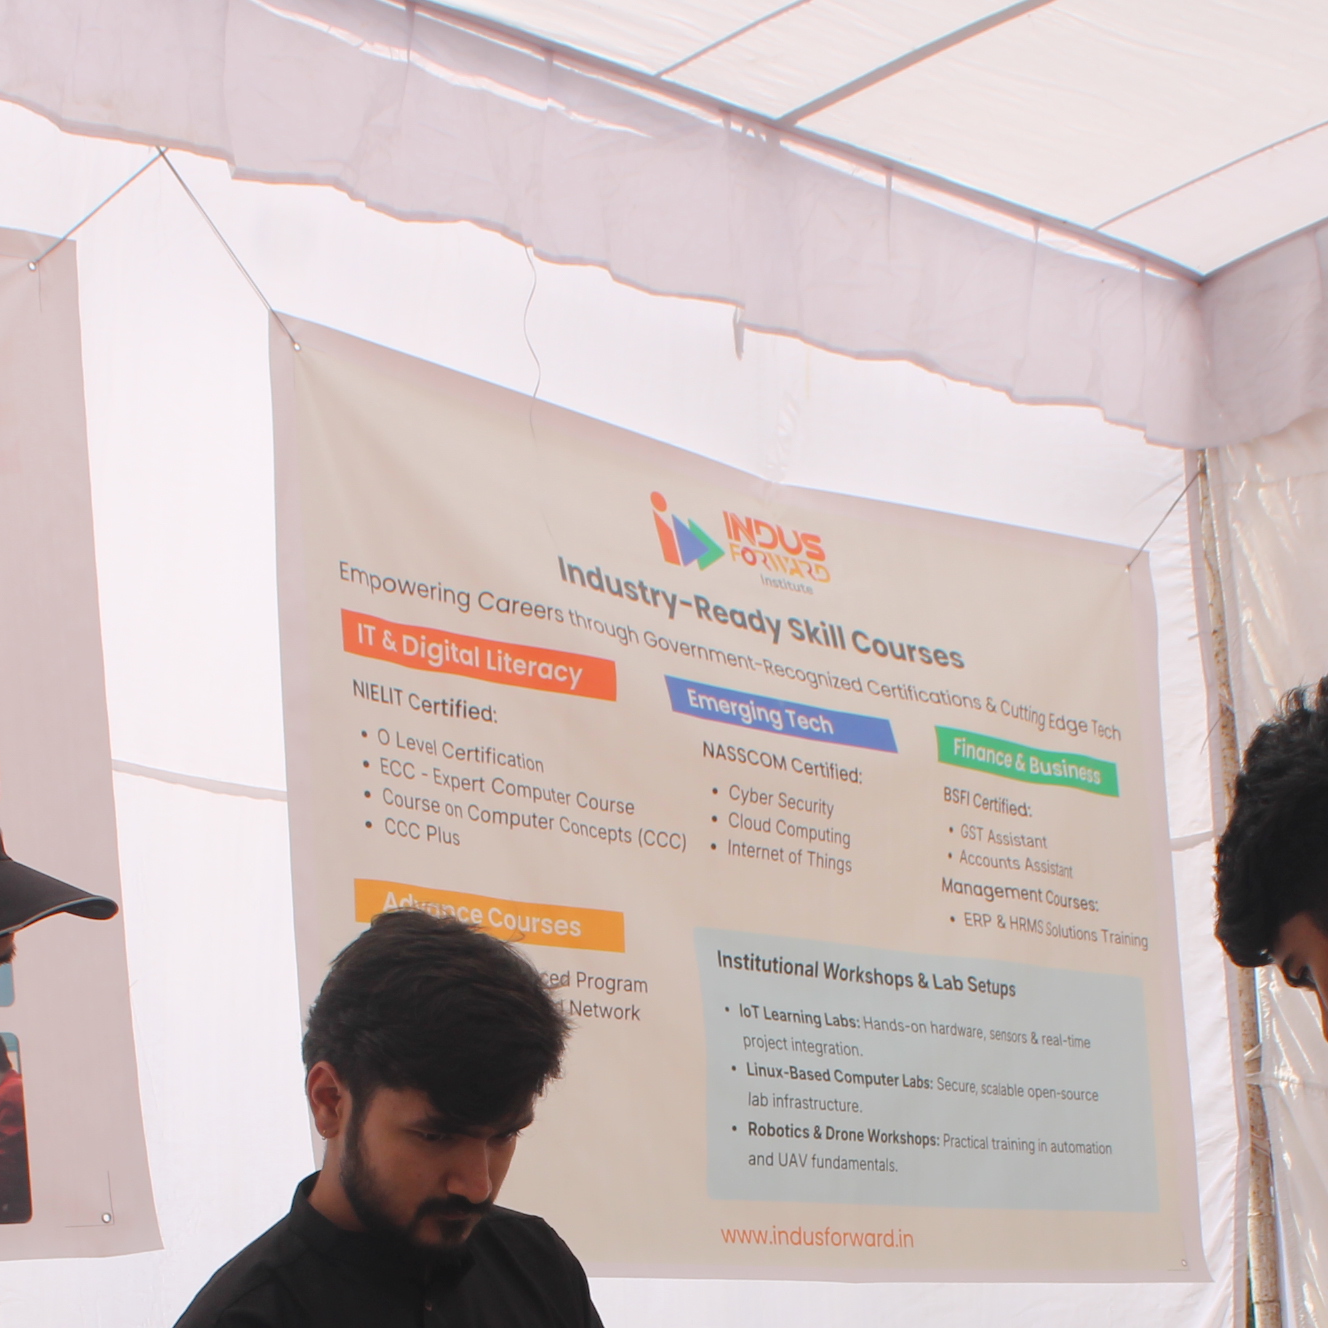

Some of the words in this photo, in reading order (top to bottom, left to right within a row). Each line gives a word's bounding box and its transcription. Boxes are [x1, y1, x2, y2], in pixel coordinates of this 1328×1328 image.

[723, 510, 826, 561] INDUS
[729, 543, 831, 583] FORWARD
[761, 573, 814, 594] Institute
[557, 555, 781, 644] Industry-Ready
[787, 616, 847, 650] Skill
[852, 629, 965, 669] Courses
[339, 560, 470, 612] Empowering
[477, 590, 564, 623] Careers
[569, 609, 639, 645] through
[644, 630, 863, 692] Government-Recognized
[867, 679, 982, 710] Certifications
[985, 696, 997, 713] &
[1000, 699, 1046, 732] Cutting
[1048, 712, 1088, 737] Edge
[1091, 719, 1122, 741] Tech
[357, 623, 375, 646] IT
[381, 630, 397, 653] &
[402, 633, 480, 669] Digital
[486, 648, 583, 690] Literacy
[352, 679, 404, 707] NIELIT
[408, 692, 498, 724] Certified:
[686, 688, 784, 730] Emerging
[784, 708, 834, 735] Tech
[377, 728, 390, 746] O
[396, 731, 437, 756] Level
[442, 741, 544, 773] Certification
[702, 740, 787, 771] NASSCOM
[791, 757, 863, 785] Certified:
[953, 737, 1013, 769] Finance
[1014, 753, 1026, 772] &
[1029, 756, 1102, 785] Business
[380, 757, 415, 780] ECC
[433, 768, 485, 793] Expert
[491, 777, 571, 806] Computer
[576, 791, 635, 815] Course
[728, 783, 773, 806] Cyber
[778, 792, 834, 819] Security
[943, 786, 970, 806] BSFI
[973, 792, 1033, 818] Certified:
[382, 787, 440, 814] Course
[445, 802, 463, 819] on
[467, 803, 554, 831] Computer
[559, 817, 632, 844] Concepts
[637, 827, 687, 853] (CCC)
[385, 817, 420, 840] CCC
[426, 824, 461, 847] Plus
[728, 811, 771, 833] Cloud
[775, 819, 851, 849] Computing
[960, 823, 983, 842] GST
[987, 829, 1048, 849] Assistant
[727, 838, 784, 863] Internet
[788, 848, 803, 865] of
[807, 850, 852, 875] Things
[959, 850, 1021, 870] Accounts
[1024, 857, 1074, 880] Assistant
[941, 876, 1043, 902] Management
[1045, 890, 1100, 912] Courses:
[488, 907, 582, 937] Courses
[964, 912, 992, 928] ERP
[996, 914, 1006, 930] &
[1009, 915, 1044, 935] HRMS
[1045, 921, 1098, 942] Solutions
[1100, 928, 1149, 951] Training
[576, 971, 648, 995] Program
[717, 949, 819, 979] Institutional
[823, 961, 914, 990] Workshops
[917, 972, 929, 989] &
[932, 973, 964, 992] Lab
[967, 976, 1016, 999] Setups
[569, 999, 641, 1021] Network
[739, 1003, 759, 1019] IoT
[763, 1006, 822, 1029] Learning
[824, 1013, 861, 1029] Labs:
[863, 1016, 927, 1033] Hands-on
[930, 1021, 986, 1042] hardware,
[989, 1028, 1028, 1044] sensors
[1030, 1031, 1038, 1045] &
[1042, 1033, 1091, 1049] real-time
[743, 1034, 788, 1052] project
[791, 1036, 863, 1057] integration.
[746, 1061, 831, 1082] Linux-Based
[834, 1069, 899, 1088] Computer
[902, 1073, 933, 1090] Labs:
[937, 1076, 978, 1096] Secure,
[981, 1082, 1024, 1097] scalable
[1027, 1086, 1099, 1101] open-source
[748, 1091, 768, 1107] lab
[772, 1092, 863, 1113] infrastructure.
[748, 1121, 810, 1139] Robotics
[813, 1125, 822, 1140] &
[825, 1126, 864, 1142] Drone
[867, 1128, 940, 1149] Workshops:
[943, 1133, 989, 1149] Practical
[991, 1137, 1035, 1155] training
[1038, 1138, 1048, 1152] in
[1050, 1141, 1112, 1155] automation
[748, 1152, 774, 1167] and
[778, 1153, 808, 1168] UAV
[811, 1153, 898, 1173] fundamentals.
[720, 1224, 915, 1250] www.indusforward.in
